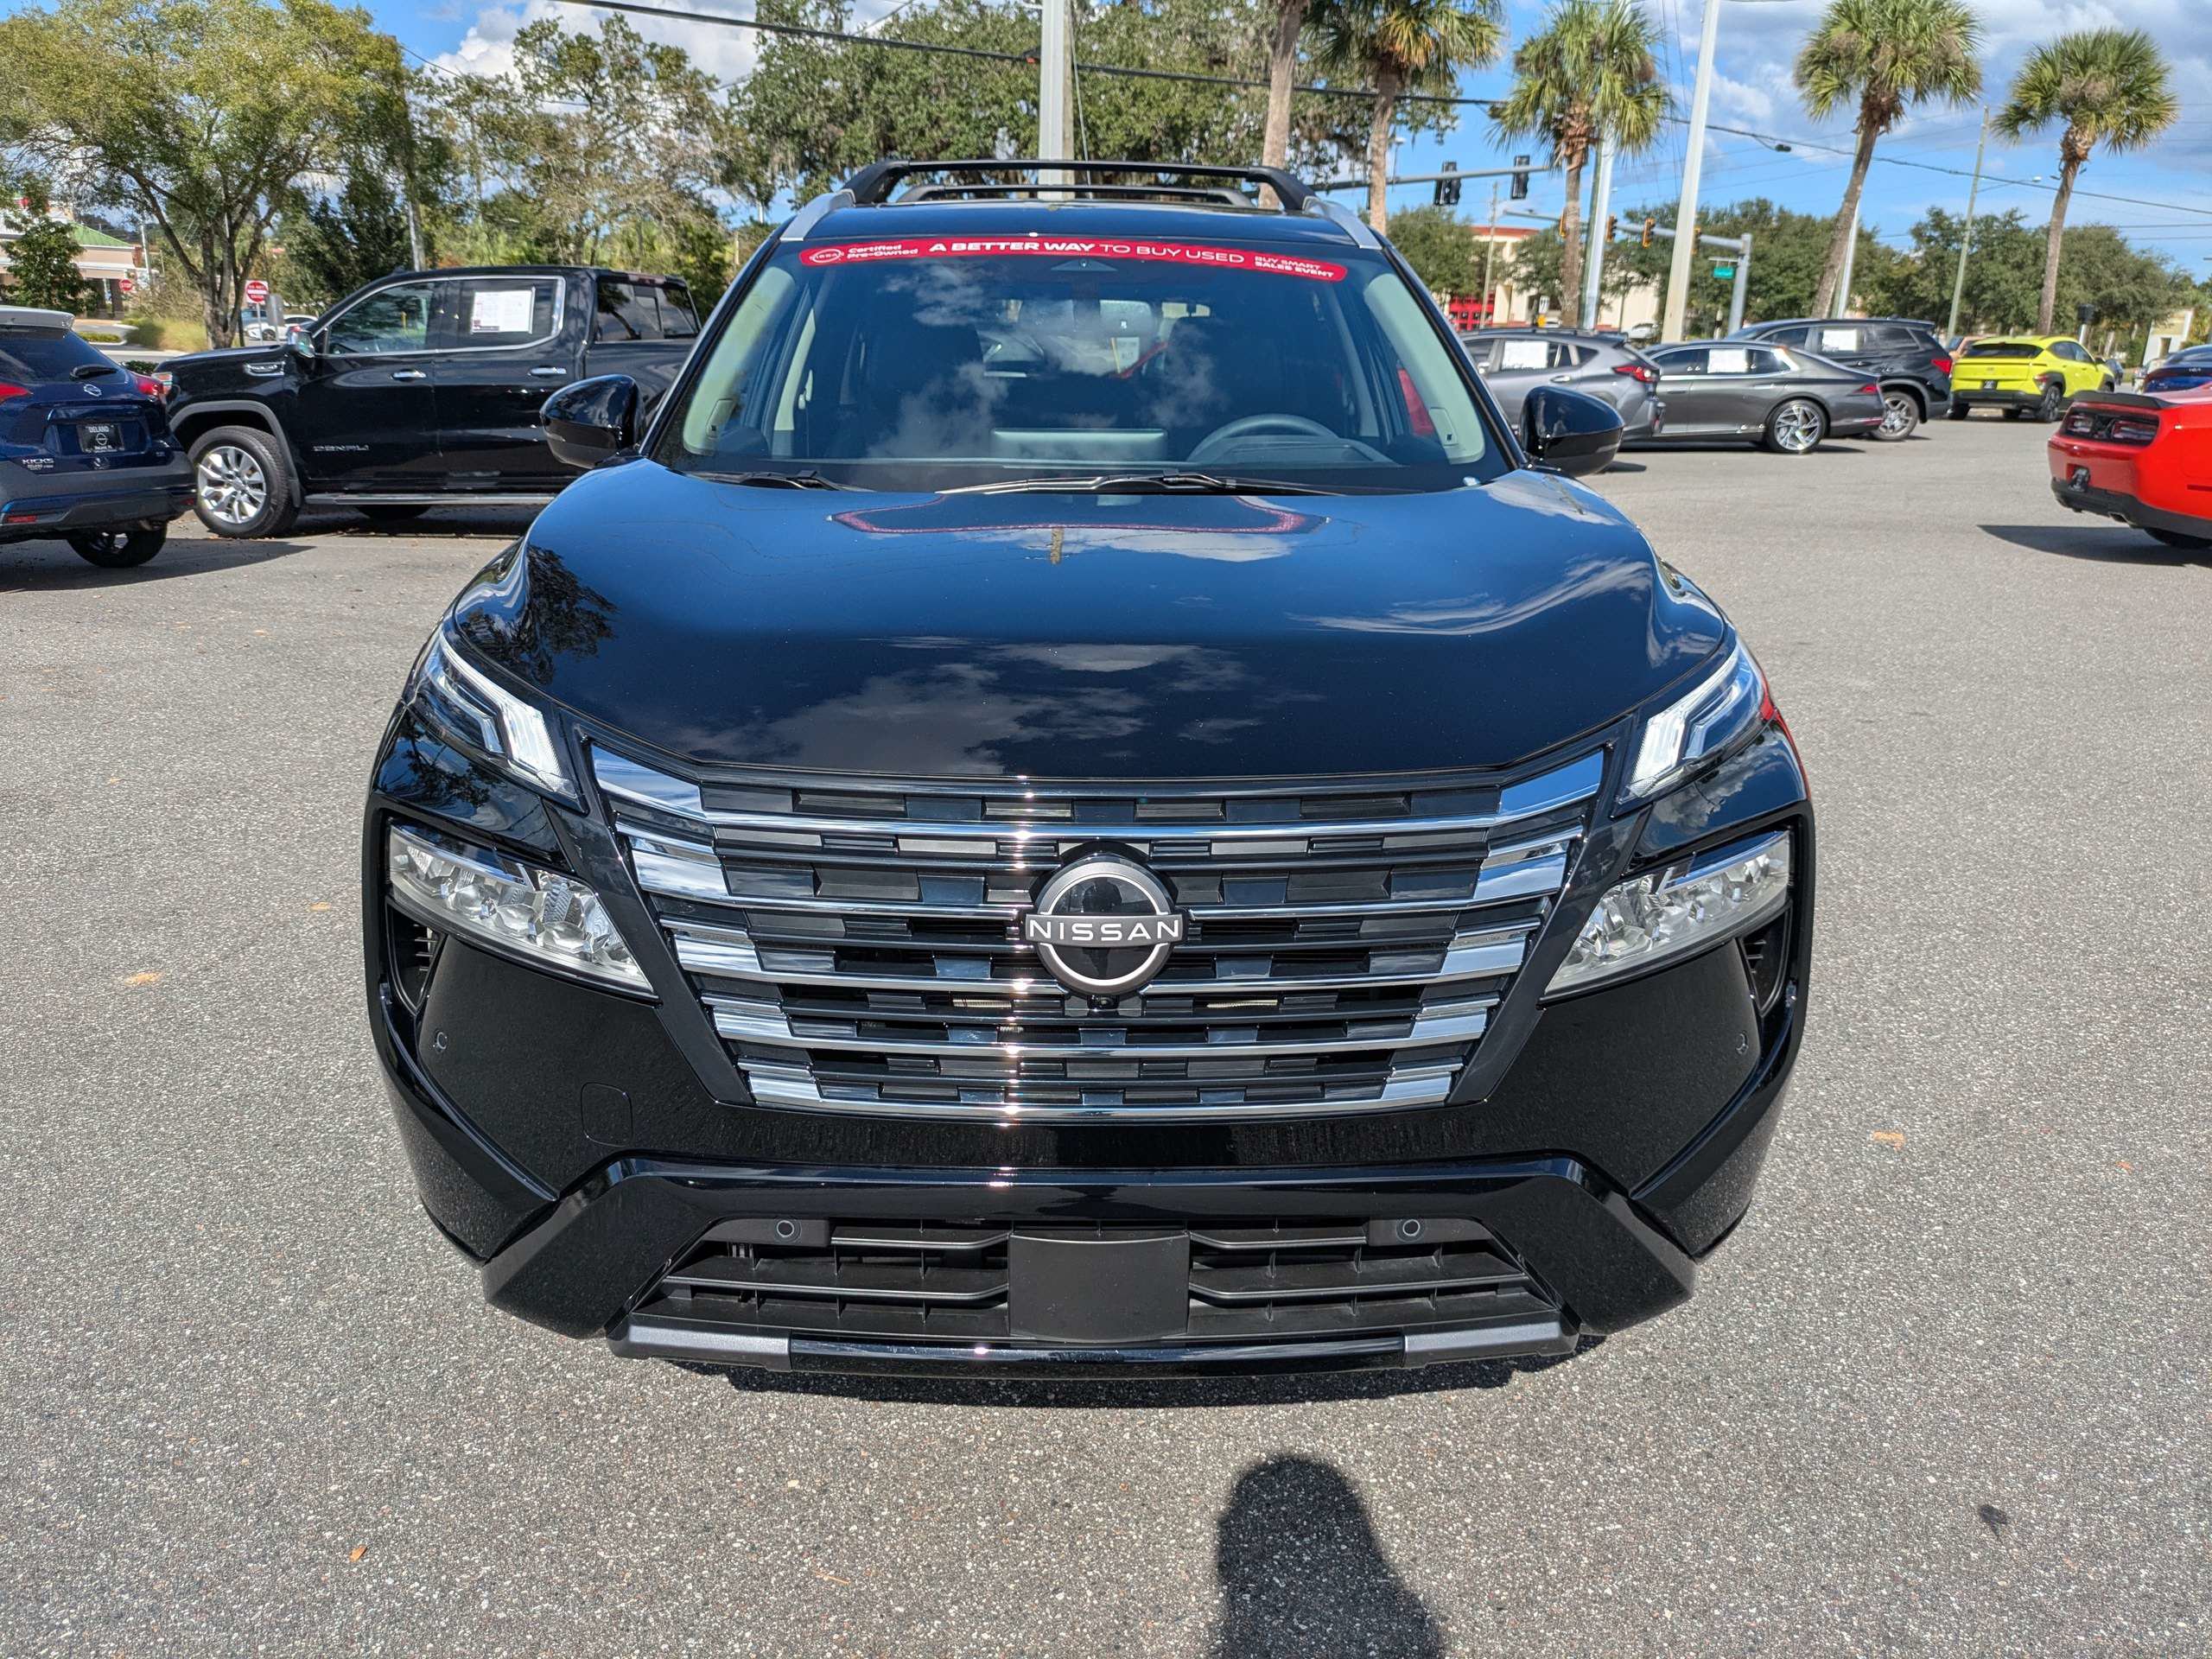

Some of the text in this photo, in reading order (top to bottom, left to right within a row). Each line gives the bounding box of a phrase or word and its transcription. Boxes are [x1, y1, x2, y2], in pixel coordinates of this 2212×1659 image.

[847, 248, 918, 259] Pre-Owned
[849, 245, 902, 254] Certified
[929, 242, 1244, 264] A BETTER WAY TO BUY USED
[1255, 261, 1334, 277] SALES EVENT
[1281, 259, 1321, 270] SMART
[1029, 919, 1179, 941] NISSAN
